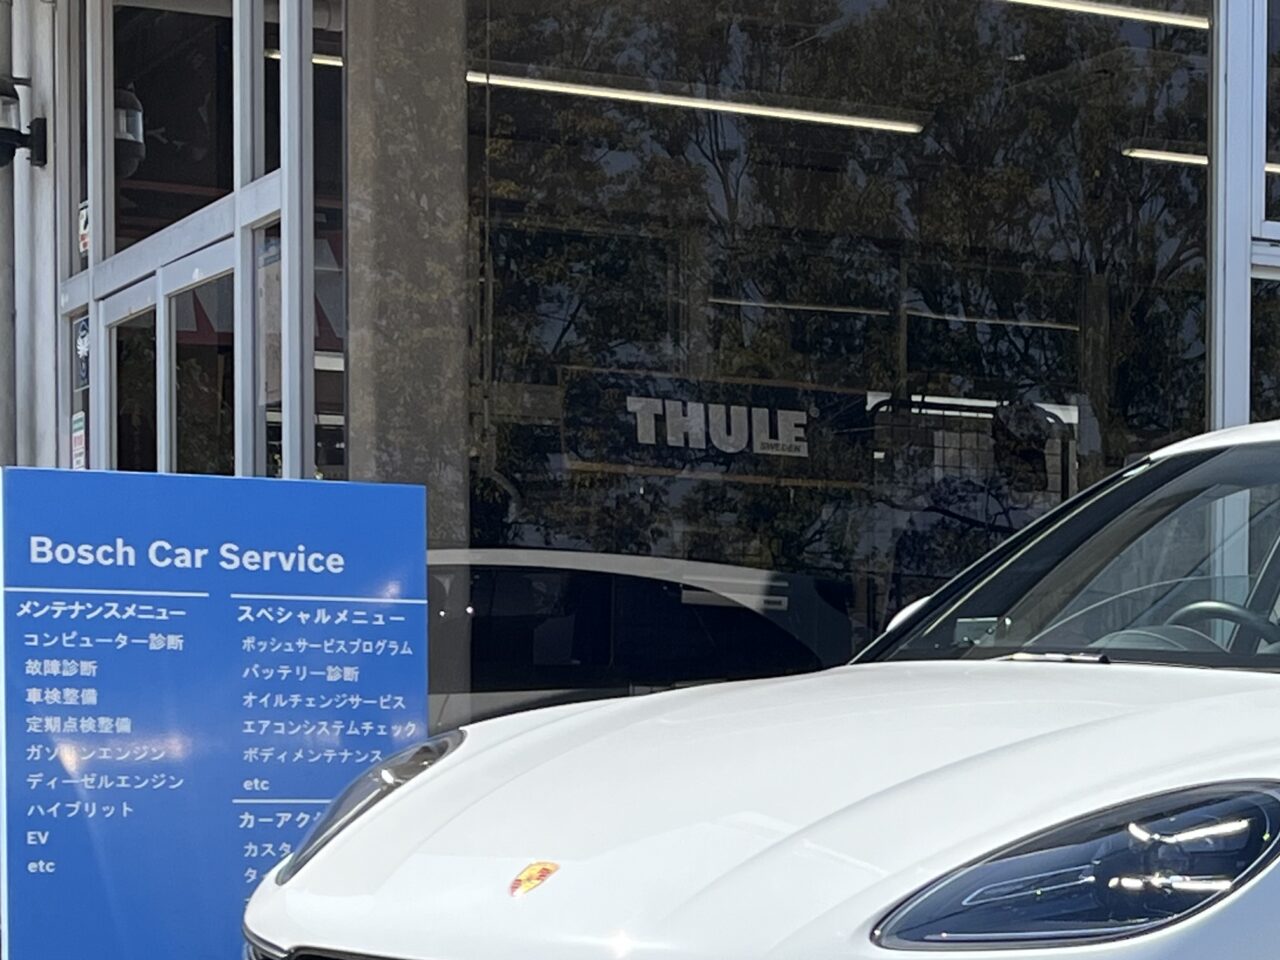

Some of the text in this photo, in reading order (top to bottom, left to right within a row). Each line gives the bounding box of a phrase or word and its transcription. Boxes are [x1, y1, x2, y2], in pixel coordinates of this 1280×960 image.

[626, 396, 809, 458] THULE
[30, 536, 345, 574] Bosch Car Service
[16, 601, 186, 620] メンテナンスメニュー
[237, 605, 406, 625] スペシャルメニュー
[24, 630, 184, 651] コンピューター診断
[24, 658, 98, 677] 故障診断
[242, 663, 360, 682] バッテリー診断
[25, 687, 98, 706] 車検整備
[242, 692, 406, 710] オイルチェンジサービス
[25, 716, 132, 734] 定期点検整備
[242, 719, 416, 737] エアコンシステムチェック
[26, 744, 166, 761] ガソンエンジン
[243, 747, 384, 764] ボディメンテナンス
[26, 772, 184, 790] ディーゼルエンジン
[243, 778, 270, 791] etc
[26, 831, 50, 845] EV
[27, 859, 56, 873] etc
